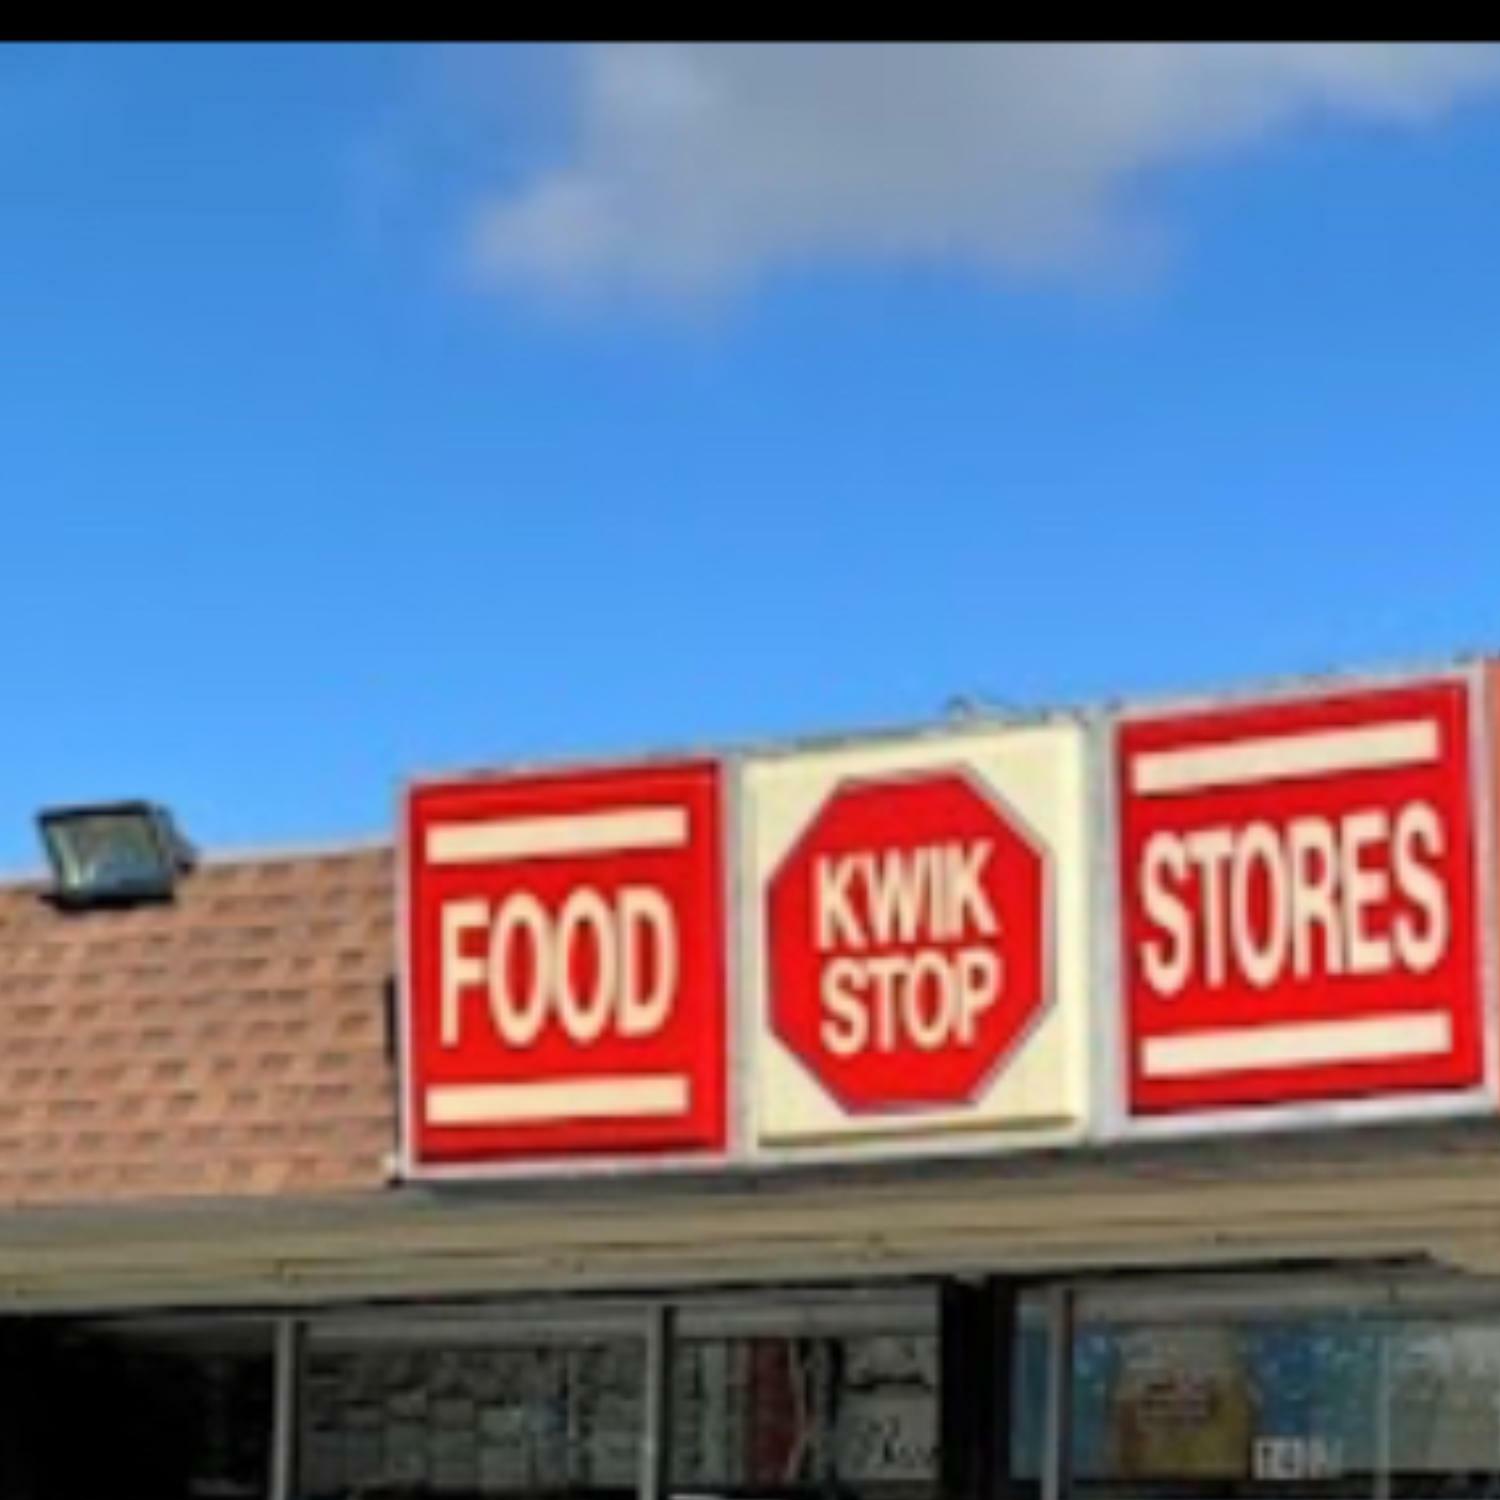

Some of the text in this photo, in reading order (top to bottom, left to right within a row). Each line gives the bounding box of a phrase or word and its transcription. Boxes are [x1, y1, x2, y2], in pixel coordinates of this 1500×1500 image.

[814, 841, 1000, 950] KWIK
[1140, 803, 1446, 996] STORES
[440, 887, 678, 1047] FOOD
[820, 950, 1000, 1056] STOP
